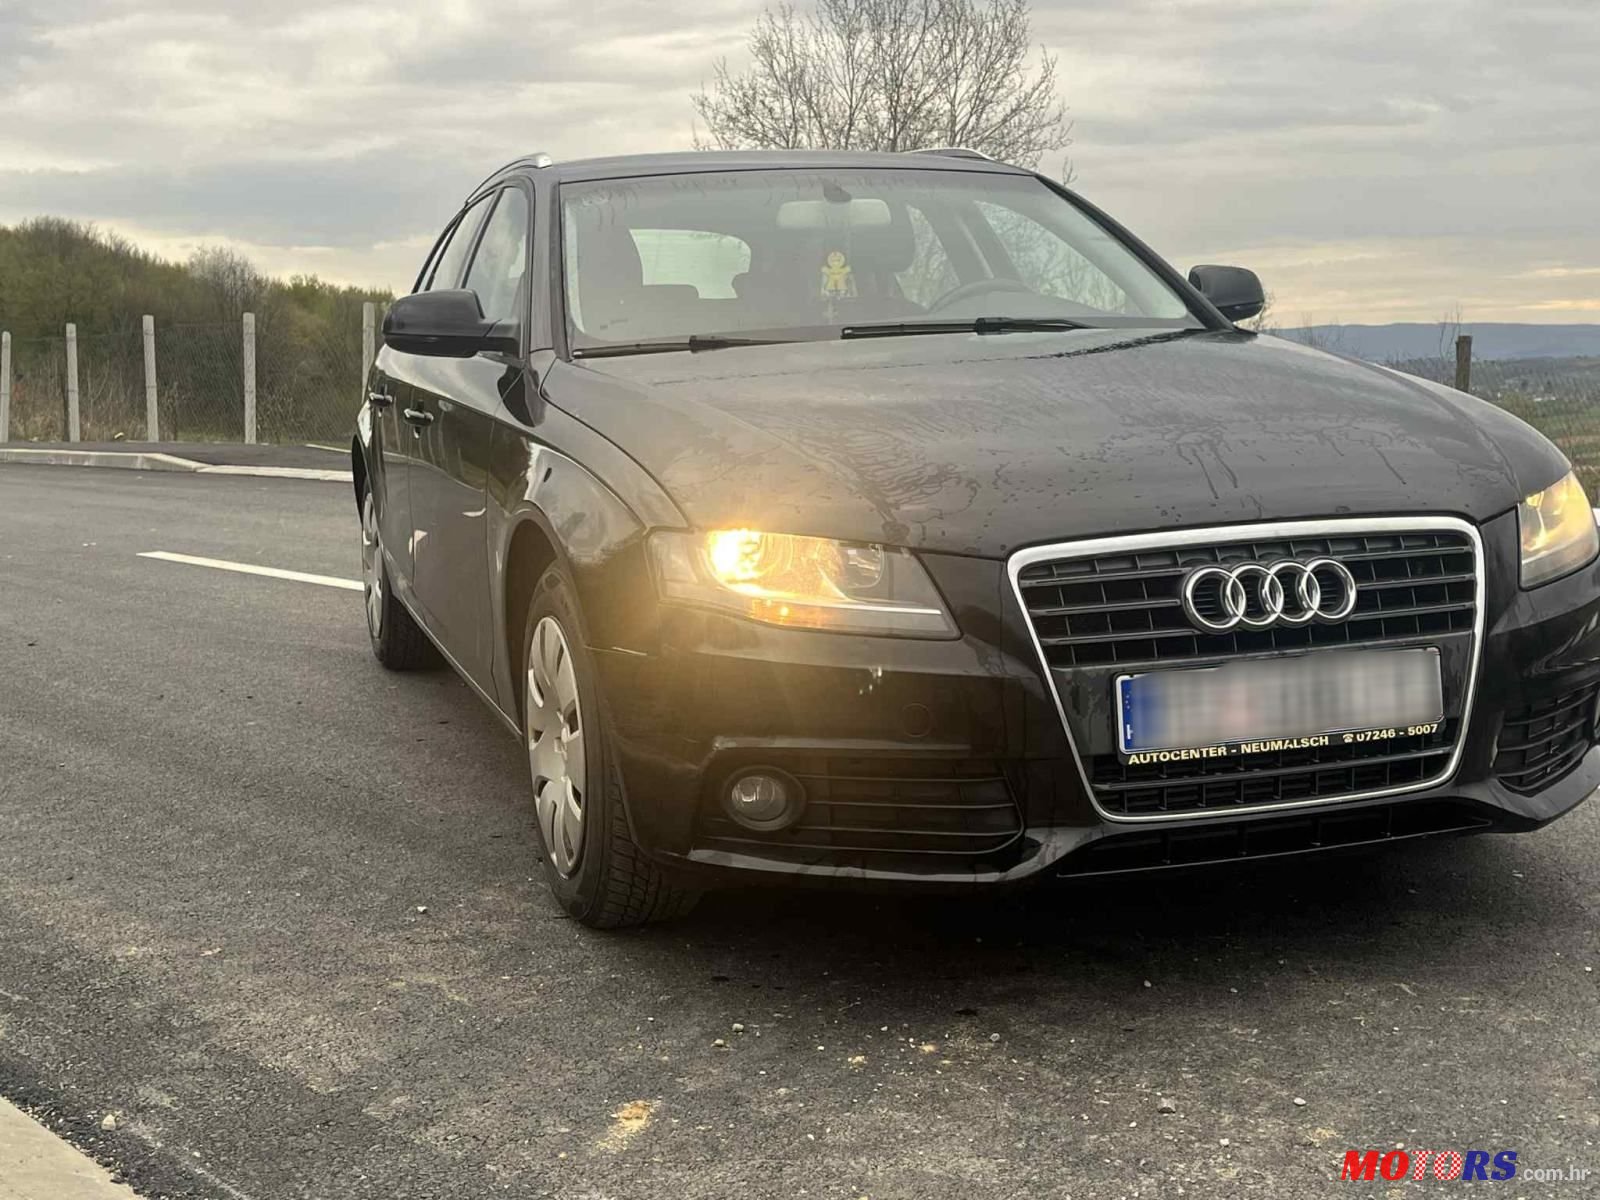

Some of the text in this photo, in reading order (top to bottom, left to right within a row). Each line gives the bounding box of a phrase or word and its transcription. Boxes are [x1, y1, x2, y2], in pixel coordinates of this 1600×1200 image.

[1128, 746, 1227, 765] AUTOCENTER
[1241, 735, 1329, 754] NEUMALSCH
[1356, 728, 1396, 742] 07246
[1407, 723, 1438, 737] 5007
